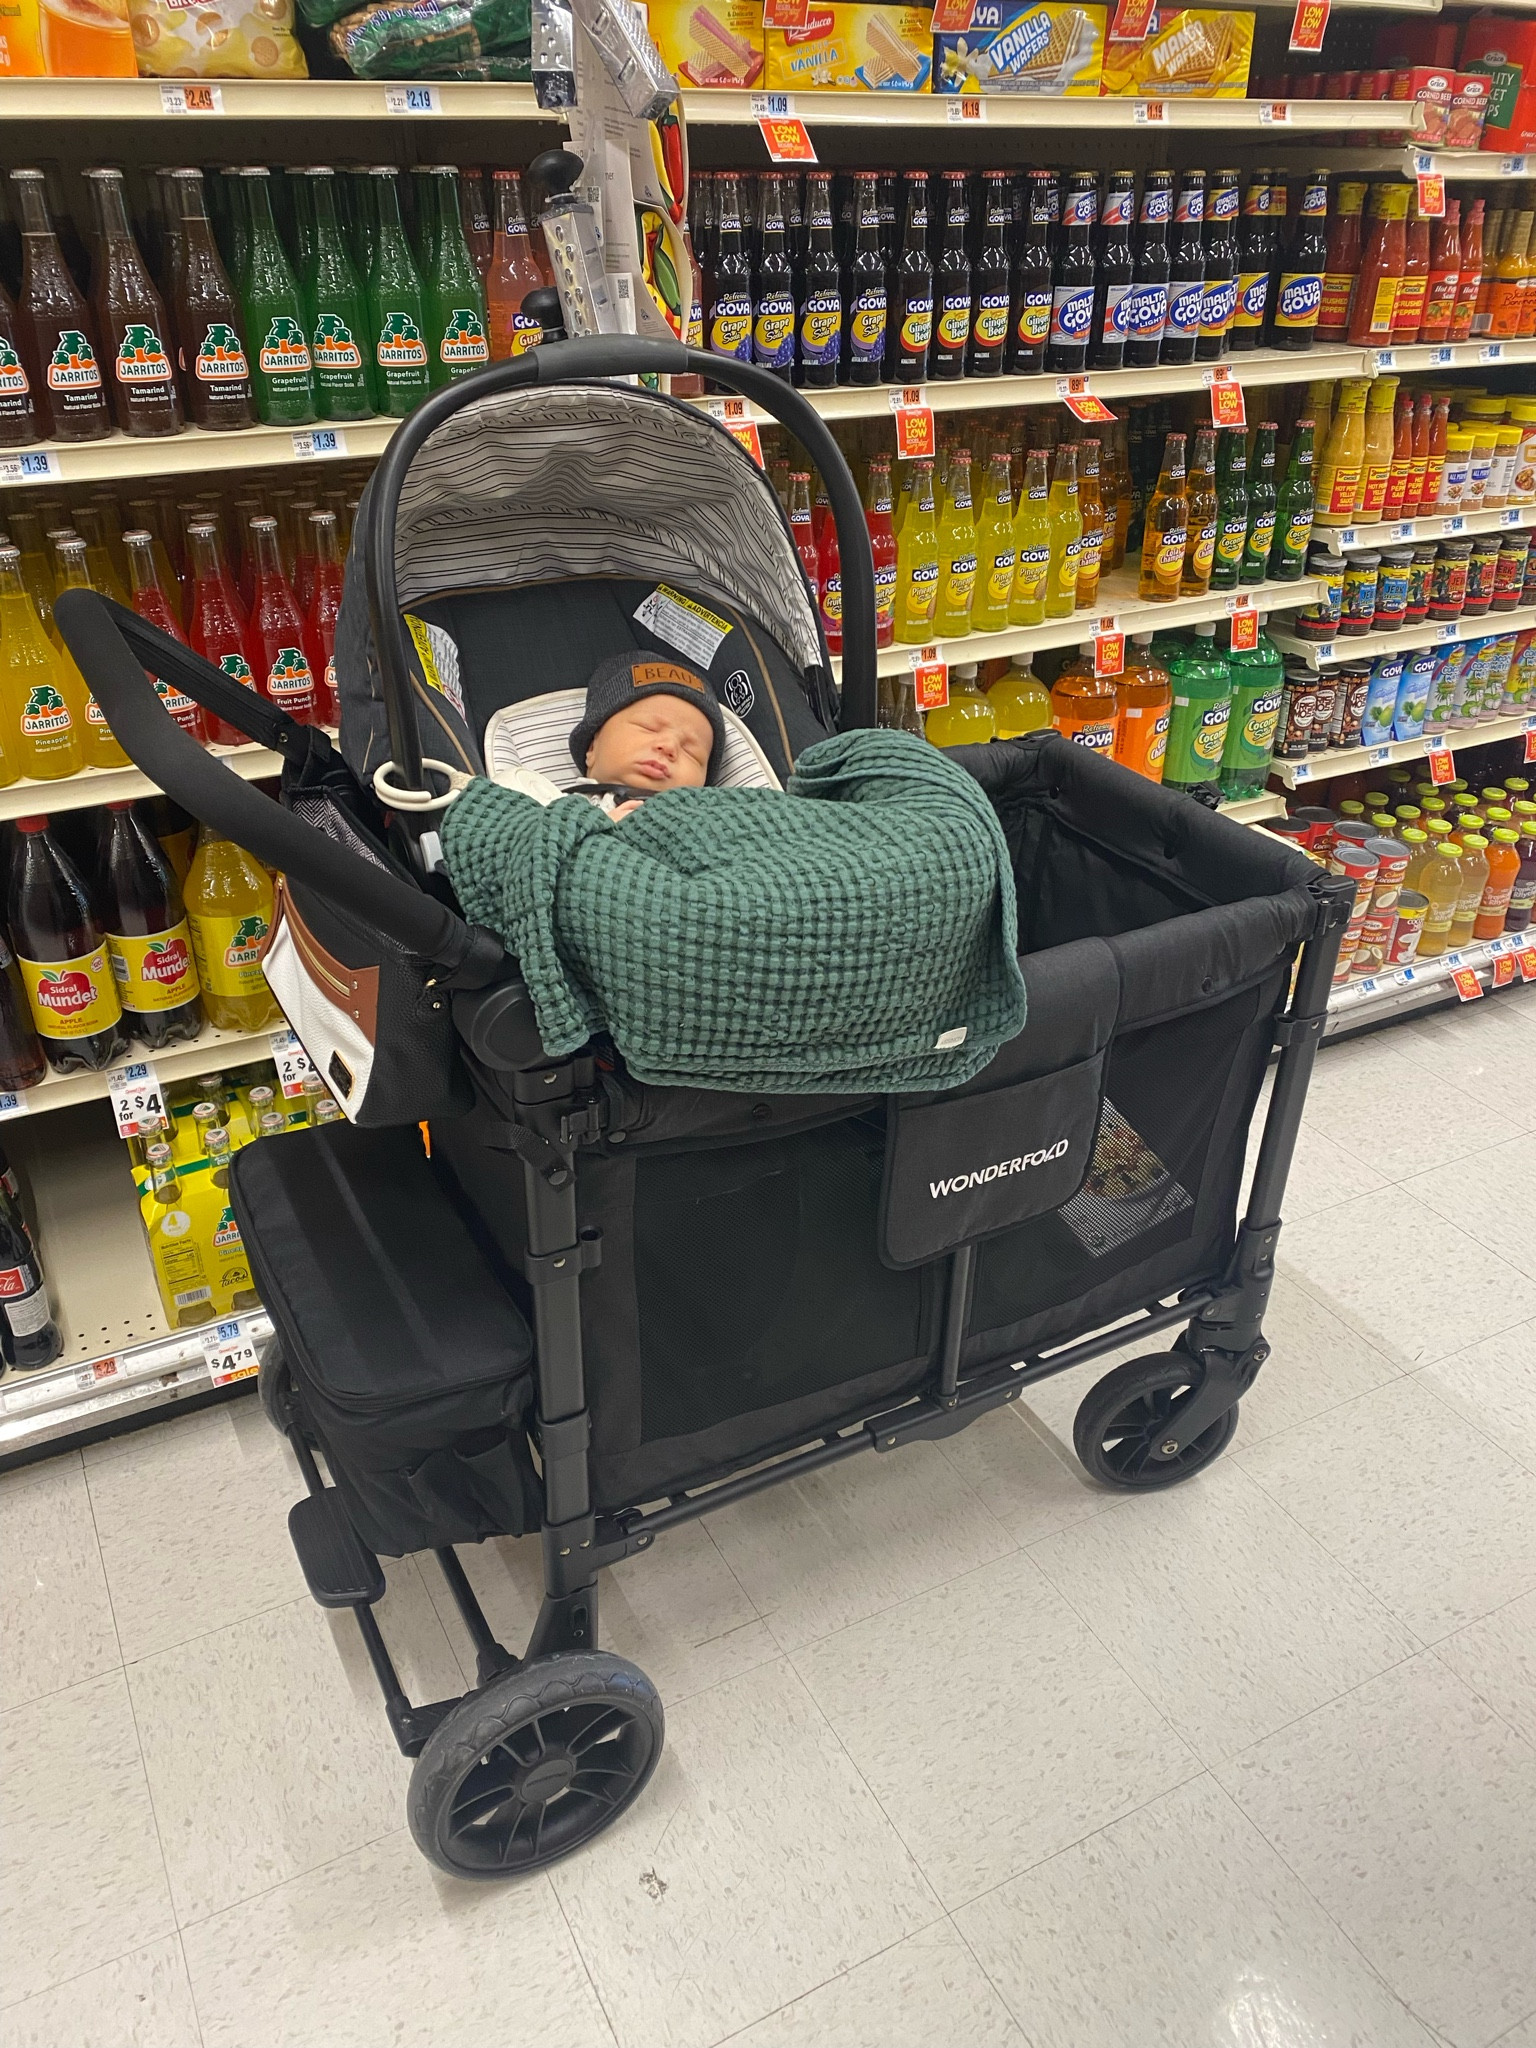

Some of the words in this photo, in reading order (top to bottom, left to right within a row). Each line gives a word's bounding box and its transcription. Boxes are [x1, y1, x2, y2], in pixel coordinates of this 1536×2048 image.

[1126, 7, 1146, 18] LOW
[1304, 6, 1323, 18] LOW
[1302, 17, 1321, 29] LOW
[990, 12, 1050, 70] VANILLA
[1152, 21, 1204, 73] MANGO
[1010, 32, 1049, 73] WAFERS
[1486, 54, 1504, 63] Grace
[791, 49, 838, 72] VANILLA
[1430, 80, 1444, 88] Grace
[1466, 86, 1480, 94] Grace
[184, 88, 212, 107] $2.49
[406, 90, 431, 107] $2.19
[1417, 91, 1439, 100] CORNED
[1440, 92, 1451, 100] BEEF
[1453, 97, 1475, 105] CORNED
[768, 97, 787, 111] $1.09
[962, 100, 980, 116] $1.19
[771, 126, 796, 134] LOW
[775, 134, 800, 143] LOW
[1304, 197, 1326, 208] GOYA
[721, 221, 741, 230] GOYA
[766, 221, 784, 230] GOYA
[862, 217, 879, 225] GOYA
[1284, 280, 1319, 299] MALTA
[859, 298, 886, 310] GOYA
[946, 296, 971, 309] GOYA
[982, 295, 1009, 308] GOYA
[1027, 293, 1052, 306] GOYA
[1132, 290, 1166, 307] MALTA
[1282, 290, 1320, 313] GOYA
[717, 303, 750, 315] GOYA
[760, 302, 792, 314] GOYA
[808, 299, 840, 312] GOYA
[909, 300, 933, 312] GOYA
[1130, 302, 1167, 322] GOYA
[764, 318, 789, 331] Grape
[811, 315, 836, 328] Grape
[862, 313, 884, 325] Grape
[946, 318, 969, 330] Ginger
[982, 316, 1007, 329] Ginger
[1027, 314, 1049, 326] Ginger
[1140, 317, 1163, 328] LIGHT
[721, 319, 746, 333] Grape
[863, 325, 879, 336] Soda
[909, 323, 932, 334] Ginger
[723, 332, 740, 343] Soda
[766, 330, 783, 342] Soda
[813, 329, 830, 340] Soda
[315, 352, 355, 362] JARRITOS
[381, 350, 421, 359] JARRITOS
[445, 346, 484, 356] JARRITOS
[265, 355, 307, 366] JARRITOS
[121, 363, 167, 375] JARRITOS
[200, 361, 244, 373] JARRITOS
[53, 371, 98, 382] JARRITOS
[272, 376, 306, 385] Grapefruit
[131, 386, 164, 395] Tamarind
[210, 384, 241, 392] Tamarind
[65, 393, 97, 402] Tamarind
[903, 390, 919, 402] $1.09
[1218, 391, 1236, 401] LOW
[724, 402, 742, 415] $1.09
[1219, 399, 1238, 409] LOW
[906, 418, 926, 428] LOW
[906, 428, 927, 438] LOW
[312, 433, 336, 448] $1.39
[21, 455, 48, 472] $1.39
[1022, 551, 1049, 562] GOYA
[662, 587, 686, 605] WARNING
[692, 604, 728, 631] ADVERTENCIA
[1238, 619, 1254, 628] LOW
[1238, 627, 1253, 636] LOW
[1102, 642, 1119, 652] LOW
[922, 648, 936, 661] $1.09
[1103, 651, 1119, 660] LOW
[645, 668, 692, 684] BEAU
[923, 674, 942, 684] LOW
[271, 676, 311, 690] JARRITOS
[923, 682, 942, 693] LOW
[293, 695, 311, 704] Punch
[25, 713, 69, 730] JARRITOS
[177, 713, 195, 723] Punch
[1074, 732, 1112, 747] GOYA
[1254, 728, 1272, 739] Soda
[36, 735, 68, 746] Pineapple
[156, 952, 180, 965] Sidral
[142, 954, 191, 981] Mundet
[1458, 973, 1470, 981] LOW
[50, 984, 77, 994] Sidral
[167, 983, 186, 995] APPLE
[38, 986, 97, 1007] Mundet
[60, 1017, 83, 1025] APPLE
[125, 1065, 147, 1078] $2.29
[283, 1061, 292, 1072] 2
[282, 1072, 296, 1082] for
[120, 1100, 129, 1111] 2
[135, 1094, 161, 1114] $4
[119, 1111, 134, 1121] for
[929, 1138, 1069, 1200] WONDERFOLD
[168, 1214, 178, 1226] 4
[218, 1323, 238, 1338] $5.79
[230, 1366, 258, 1380] sale
